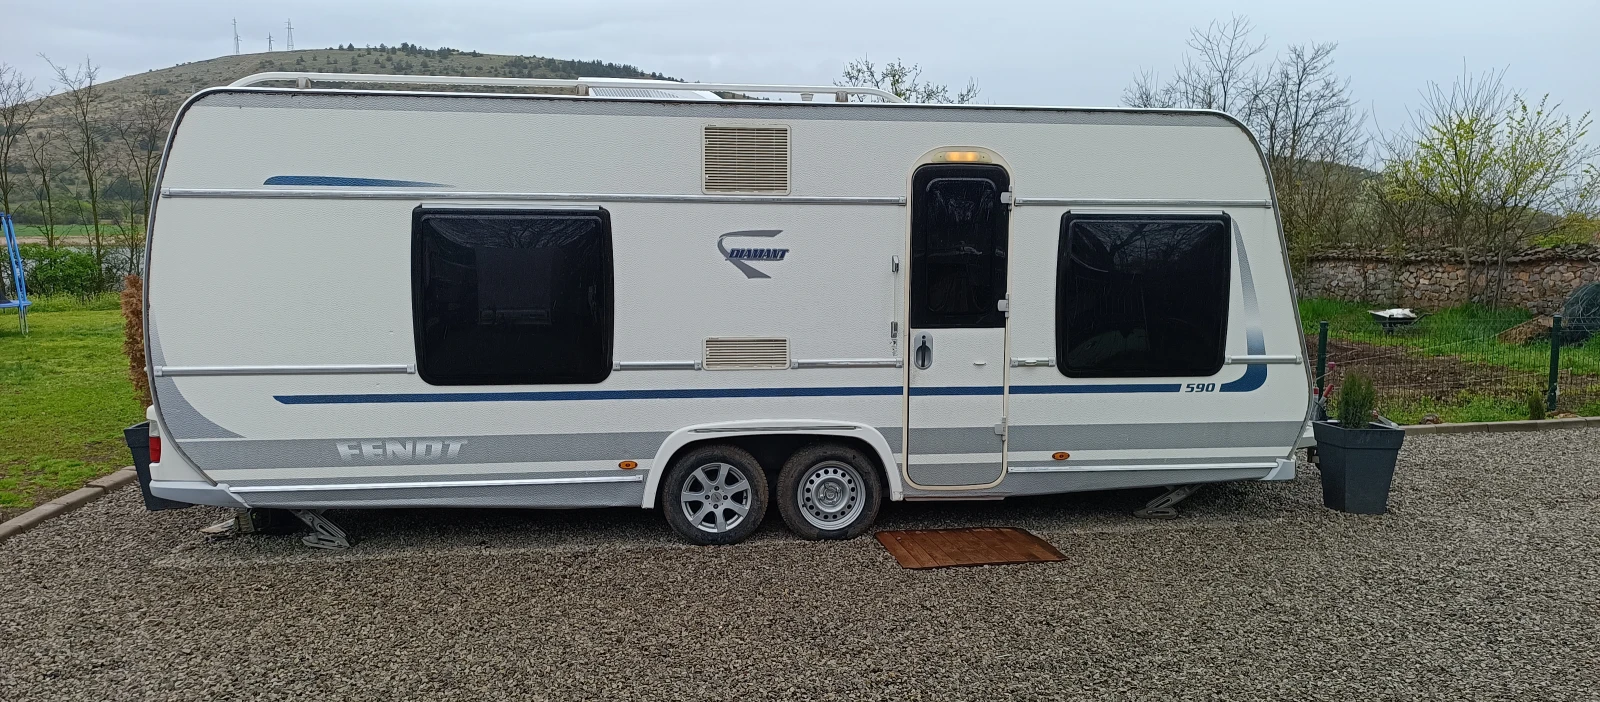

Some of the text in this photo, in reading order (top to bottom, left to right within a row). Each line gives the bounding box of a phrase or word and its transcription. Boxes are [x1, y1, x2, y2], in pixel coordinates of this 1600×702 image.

[729, 248, 789, 258] DIAMANT
[1185, 383, 1216, 392] 590
[336, 439, 469, 460] FENDT
